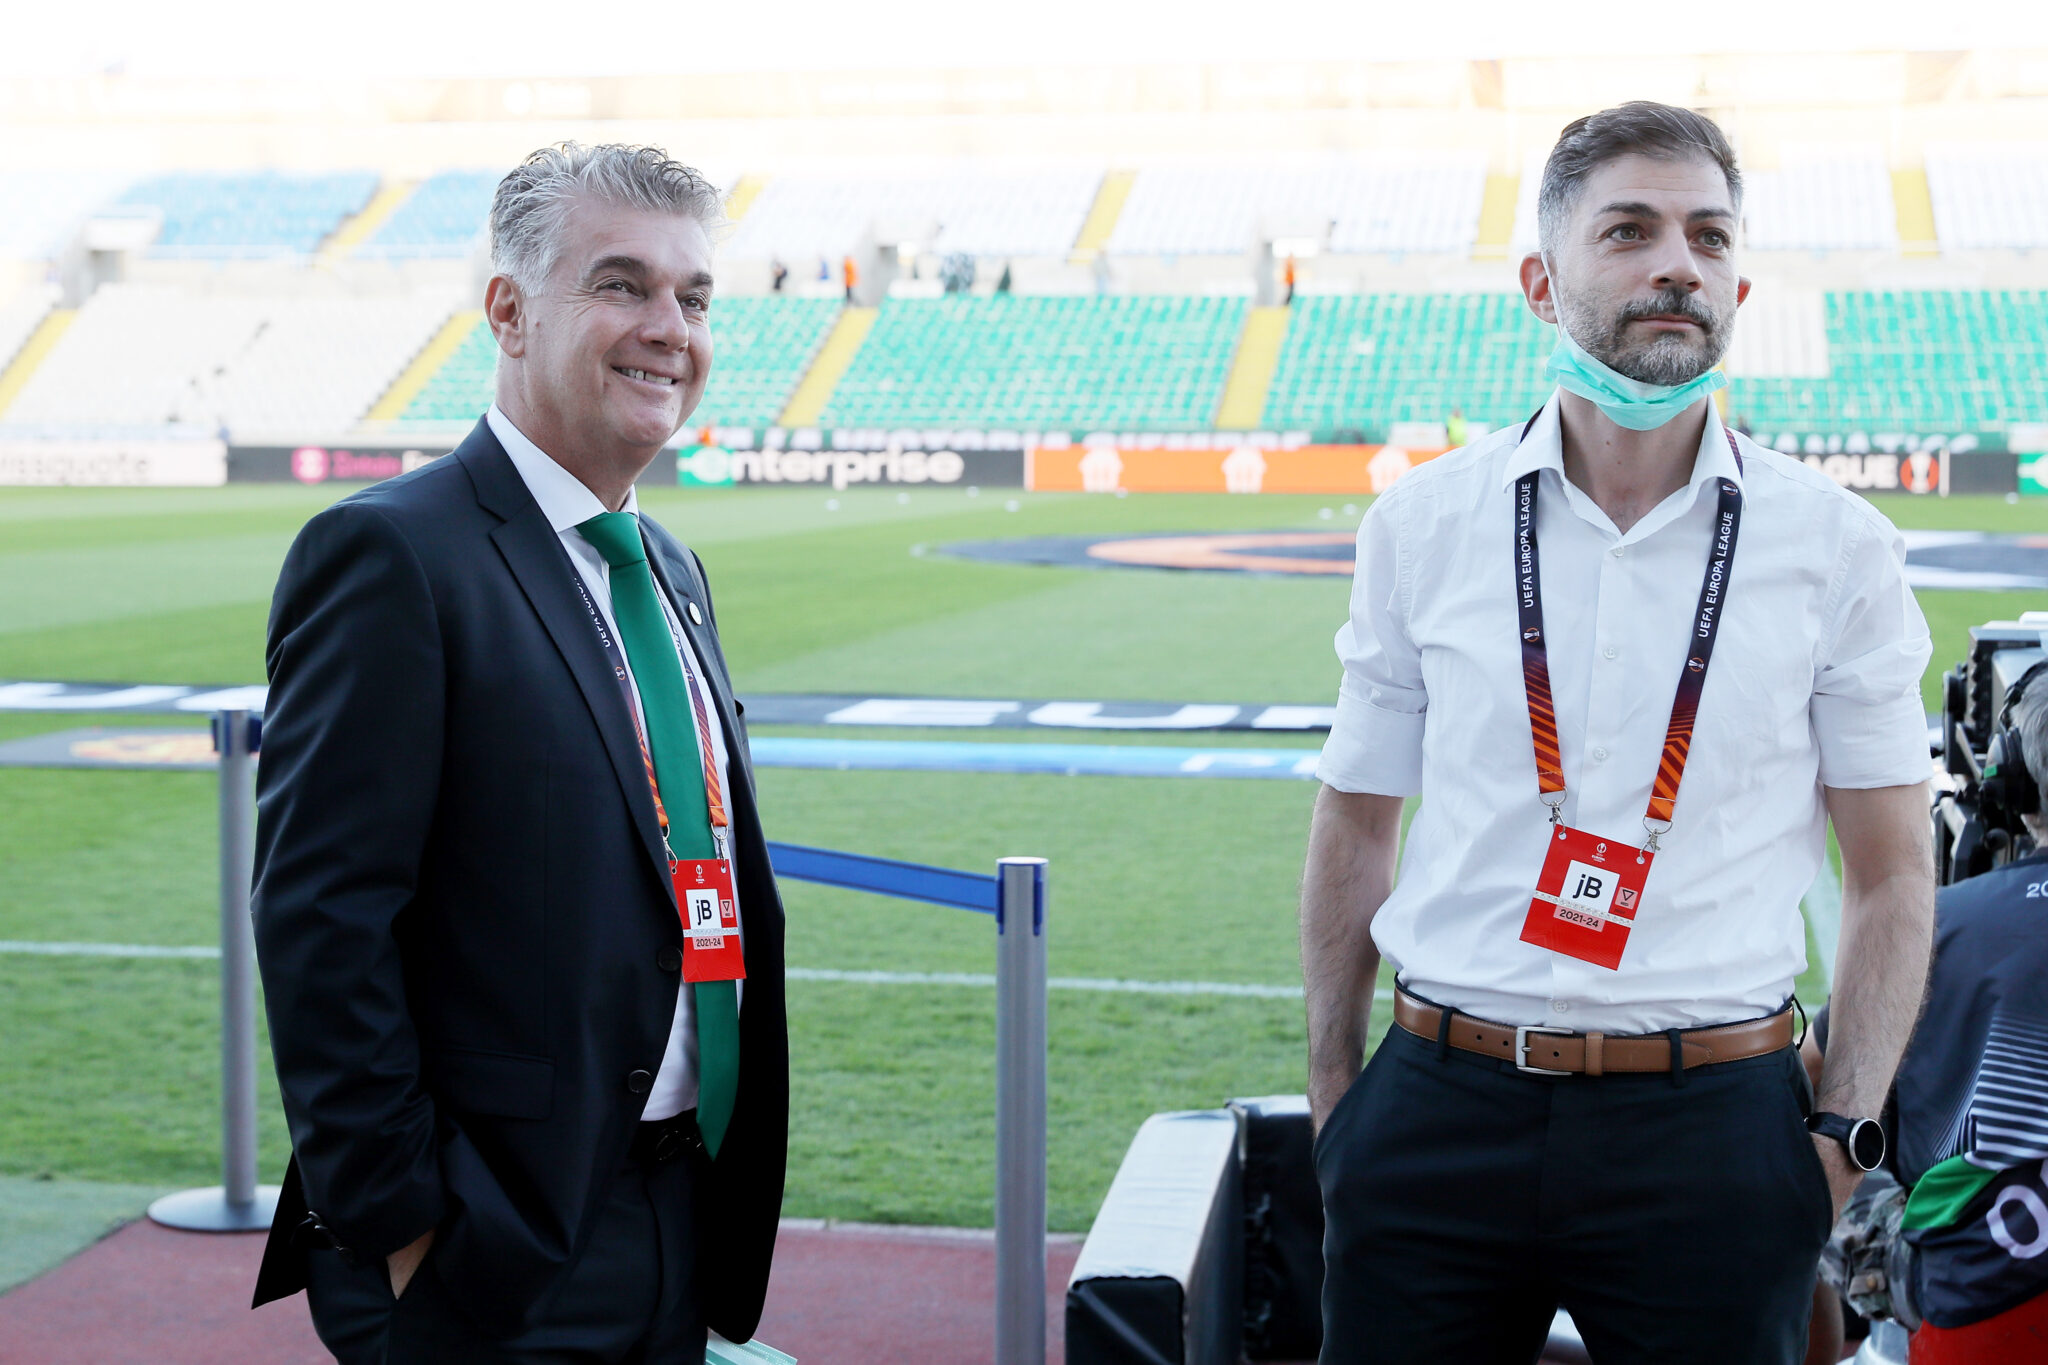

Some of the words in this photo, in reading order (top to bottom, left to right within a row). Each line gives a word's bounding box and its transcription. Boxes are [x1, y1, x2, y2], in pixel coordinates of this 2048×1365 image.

[677, 442, 965, 491] enterprise
[1520, 482, 1531, 527] LEAGUE
[1716, 511, 1734, 557] LEAGUE
[1519, 528, 1532, 575] EUROPA
[1522, 575, 1534, 608] UEFA
[1706, 559, 1725, 605] EUROPA
[1698, 606, 1715, 638] UEFA
[1572, 873, 1603, 899] jB
[695, 899, 713, 926] jB
[1559, 909, 1600, 928] 2021-24
[695, 937, 722, 948] 2021-24
